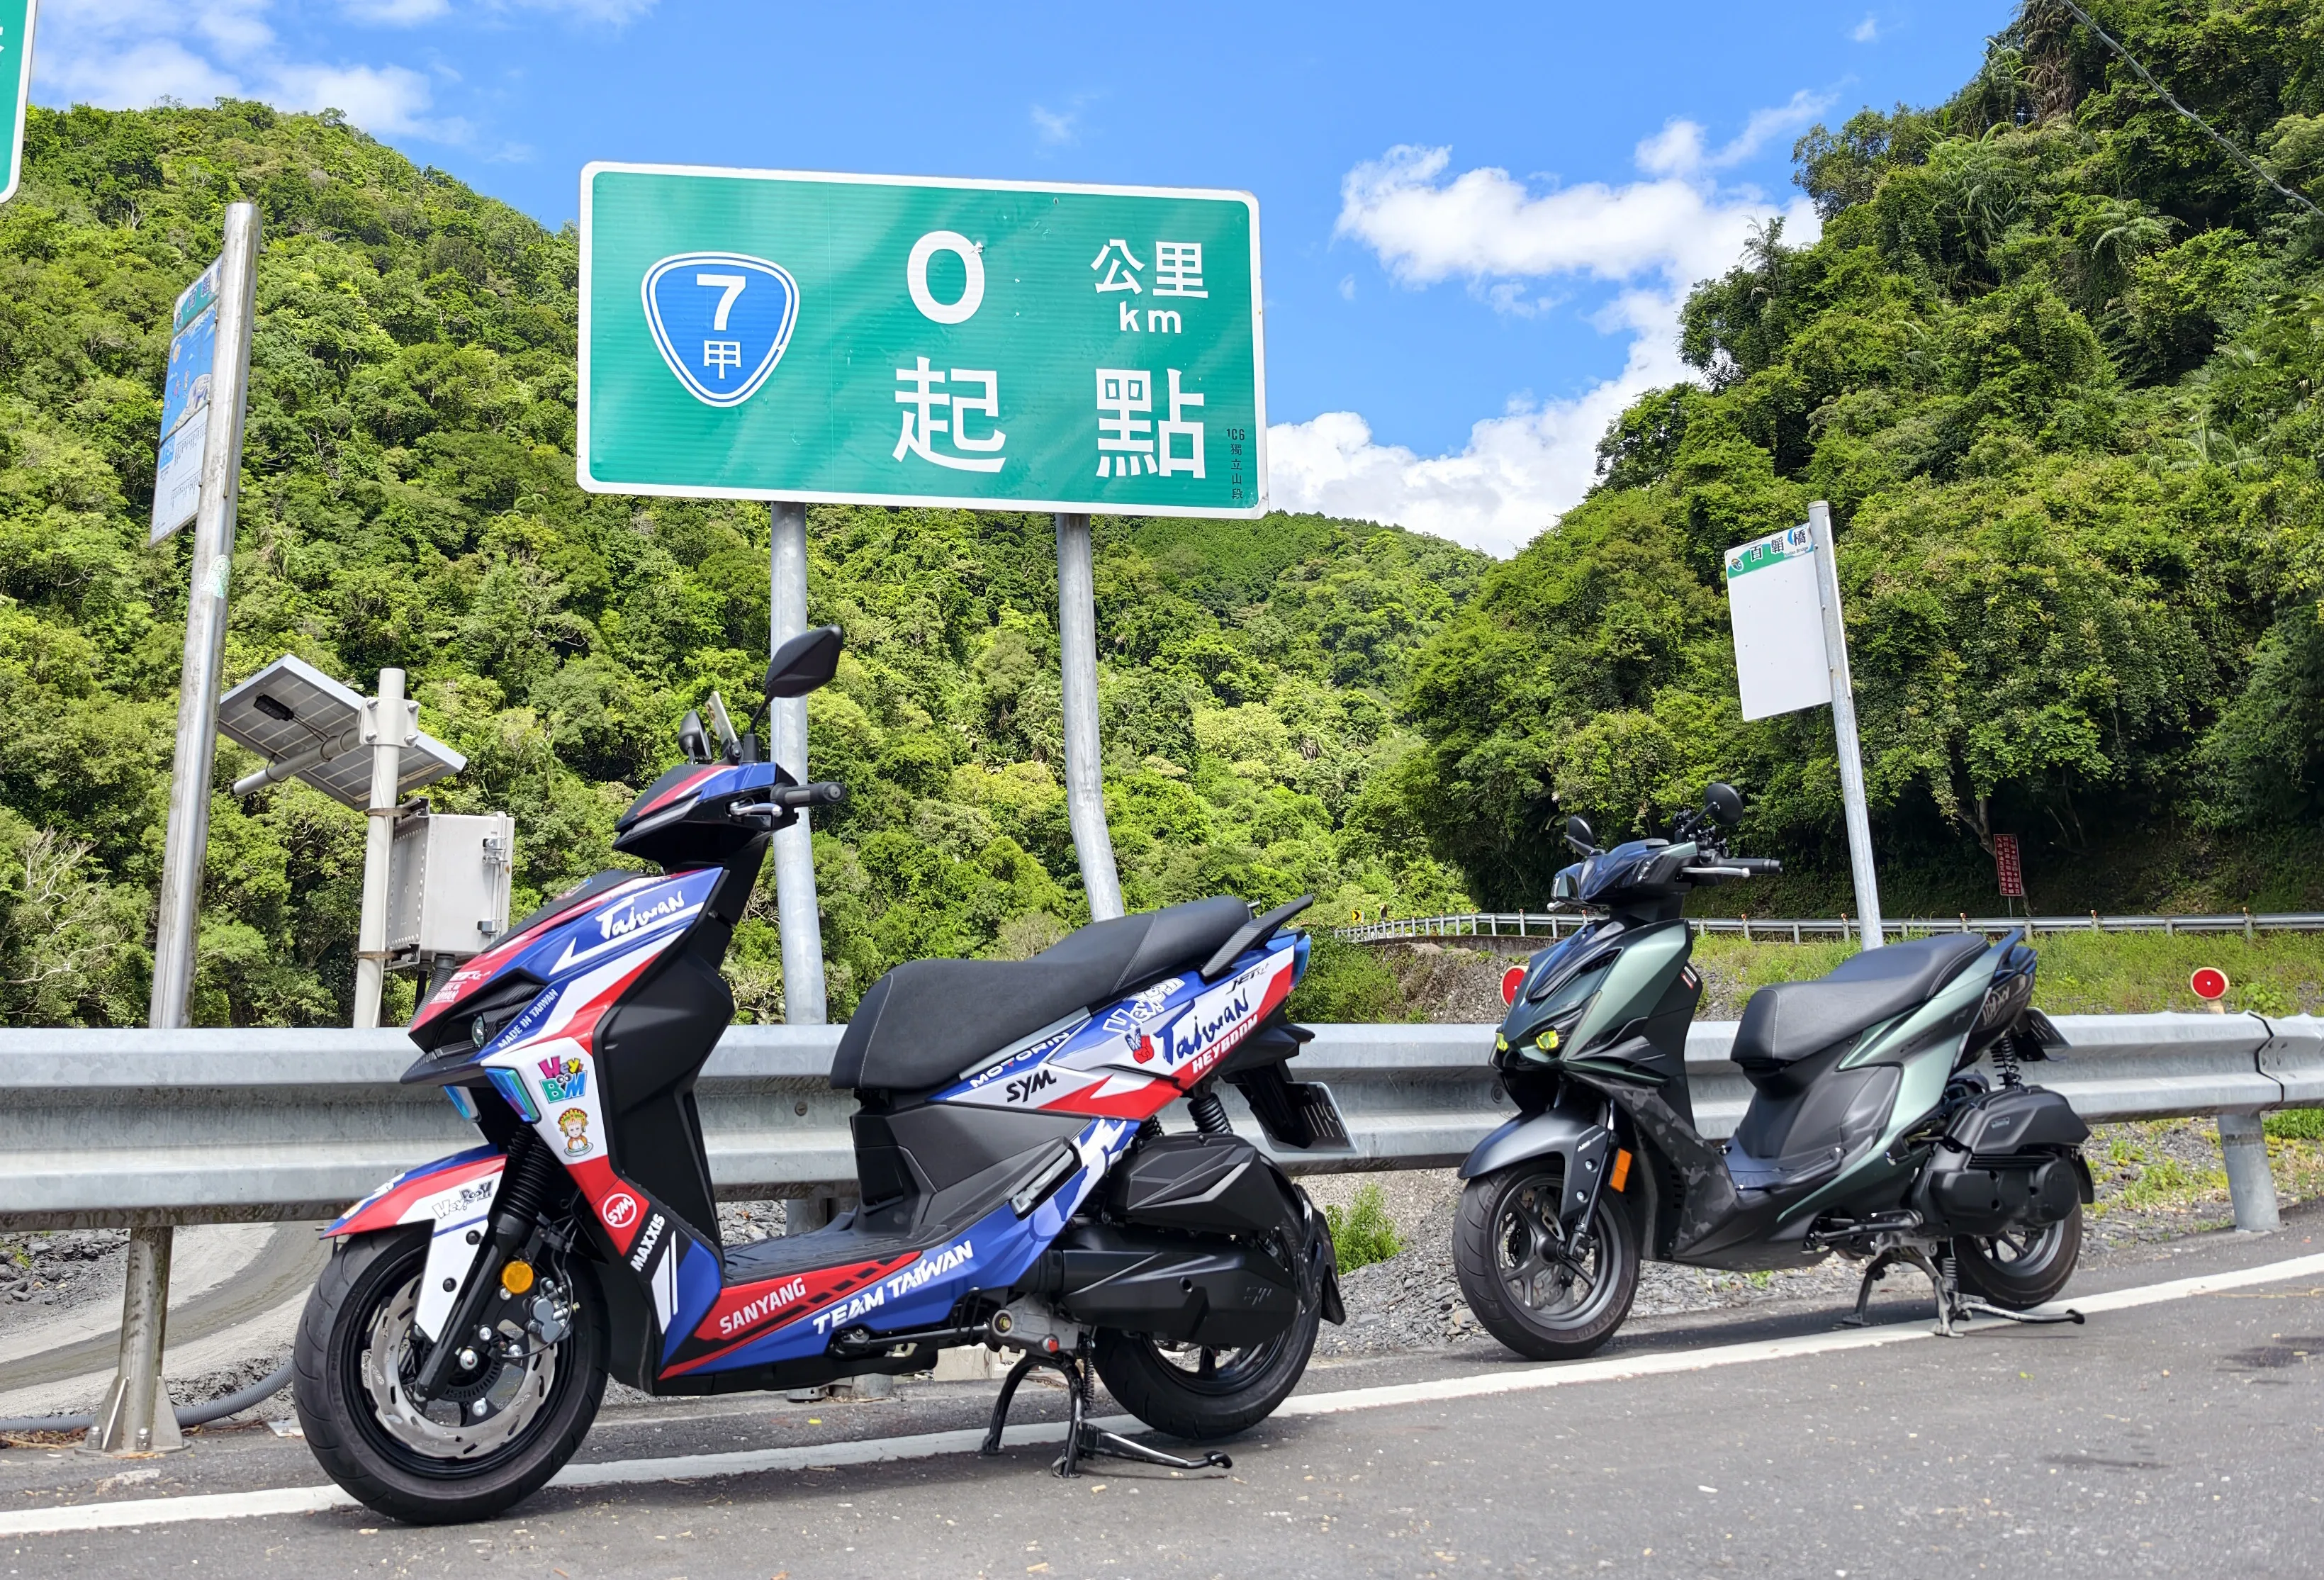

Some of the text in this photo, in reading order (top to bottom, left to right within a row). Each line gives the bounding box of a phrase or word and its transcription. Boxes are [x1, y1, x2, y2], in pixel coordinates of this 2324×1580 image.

[696, 274, 746, 332] 7
[906, 230, 1208, 324] 0 公里
[1119, 301, 1182, 335] km
[704, 340, 741, 380] 甲
[498, 988, 558, 1048] MADE IN TAIWAN
[1192, 1014, 1258, 1073] HEYBOOM
[1006, 1070, 1057, 1103] SYM
[607, 1197, 634, 1225] SYM
[630, 1214, 665, 1272] MAXXIS
[719, 1277, 806, 1334] SANYANG
[813, 1240, 974, 1335] TEAM TAIWAN
